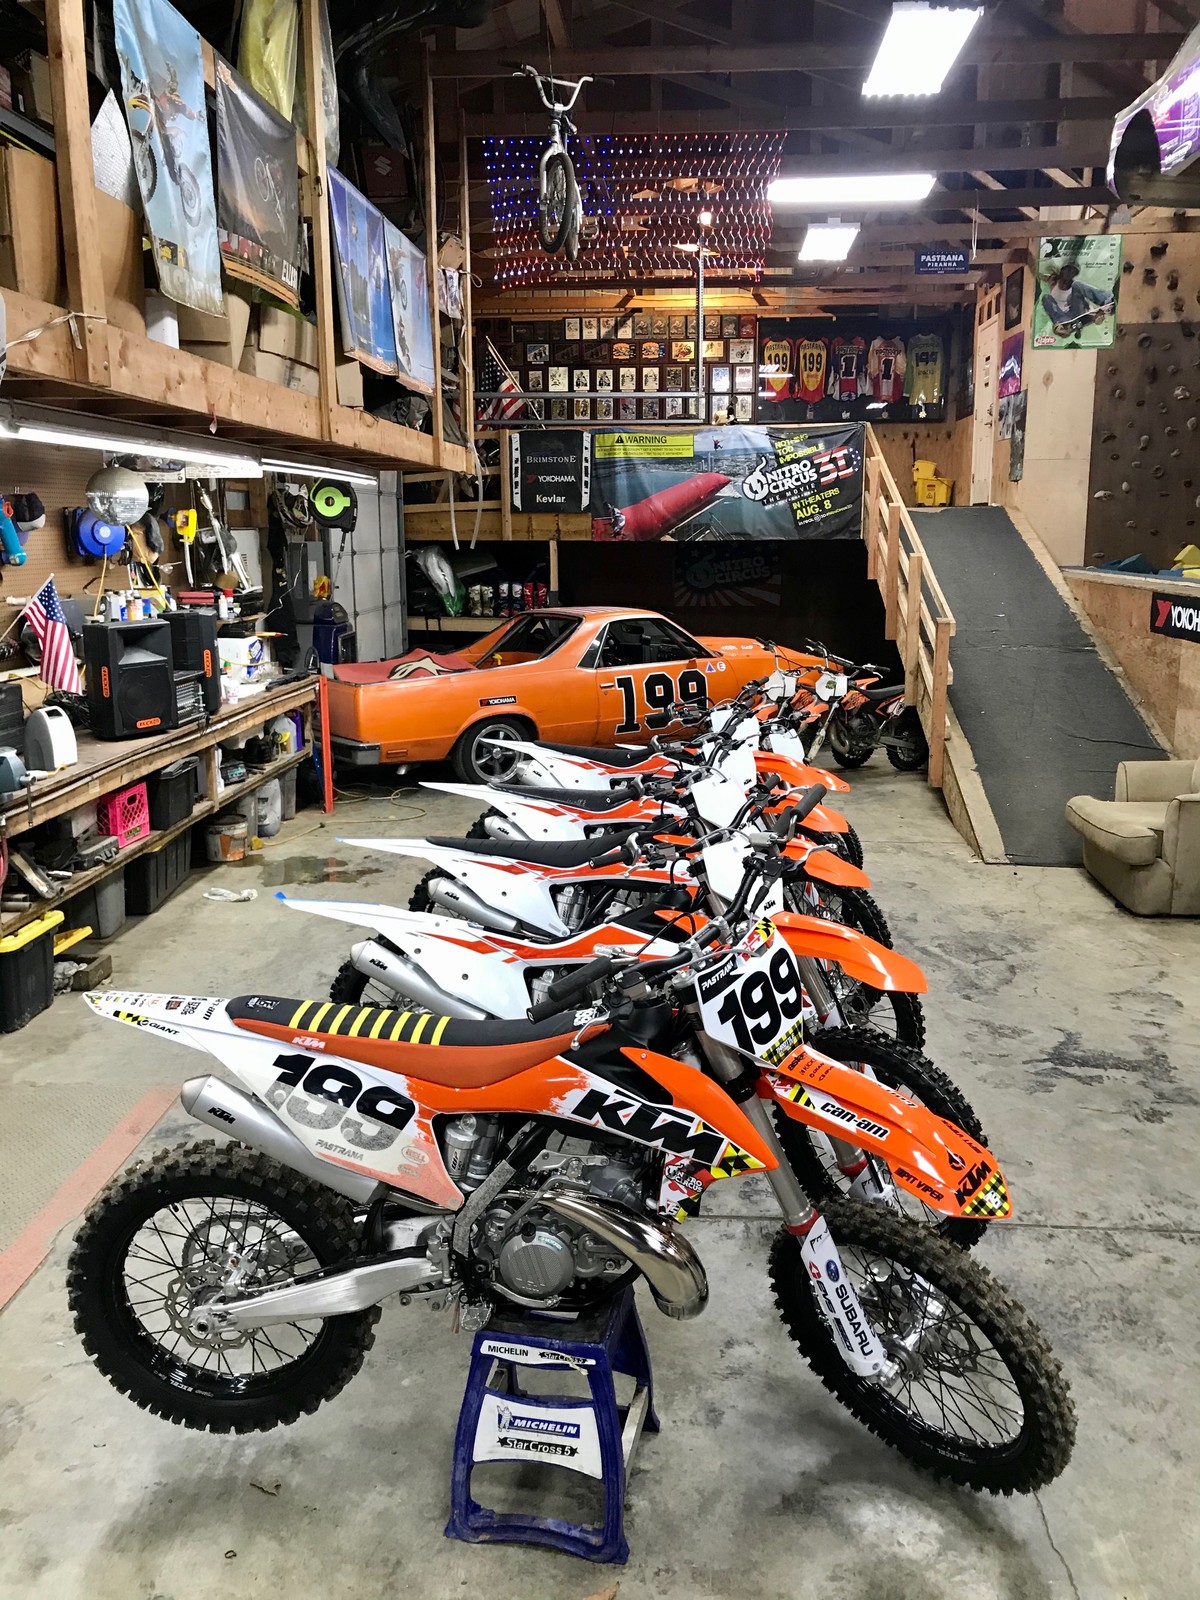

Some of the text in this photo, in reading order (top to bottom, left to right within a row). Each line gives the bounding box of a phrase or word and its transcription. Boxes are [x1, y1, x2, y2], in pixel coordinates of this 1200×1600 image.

[767, 353, 788, 372] 199
[802, 352, 822, 372] 199
[841, 354, 856, 379] 1
[880, 356, 895, 380] 1
[625, 436, 667, 444] WARNING
[526, 455, 576, 464] BRIMSTONE
[766, 460, 811, 484] NITRO
[769, 468, 818, 494] CIRCUS
[764, 494, 780, 504] THE
[786, 483, 816, 498] MOVIE
[792, 501, 800, 510] IN
[801, 488, 840, 506] THEATERS
[796, 500, 832, 520] AUG. 8
[712, 556, 765, 572] NITRO
[715, 566, 770, 584] CIRCUS
[489, 696, 516, 704] YOKOHAMA
[614, 668, 708, 735] 199
[497, 827, 509, 836] KTM
[444, 891, 460, 901] KTM
[764, 900, 776, 912] KTM
[369, 958, 388, 971] KTM
[702, 958, 734, 991] PASTRAN
[717, 947, 803, 1054] 199
[148, 1022, 180, 1035] GIANT
[292, 1036, 326, 1049] KTM
[264, 1054, 416, 1151] 199
[207, 1106, 236, 1124] KTM
[820, 1102, 889, 1138] can-am
[571, 1088, 725, 1164] KTM
[315, 1138, 364, 1161] PASTRANA
[674, 1176, 703, 1192] CIRCUS
[900, 1168, 944, 1202] PIT VIPER
[954, 1160, 992, 1207] KTM
[816, 1280, 836, 1314] EVS
[835, 1284, 873, 1356] SUBARU
[488, 1345, 529, 1356] MICHELIN
[513, 1419, 578, 1434] MICHELIN
[564, 1446, 571, 1455] 5
